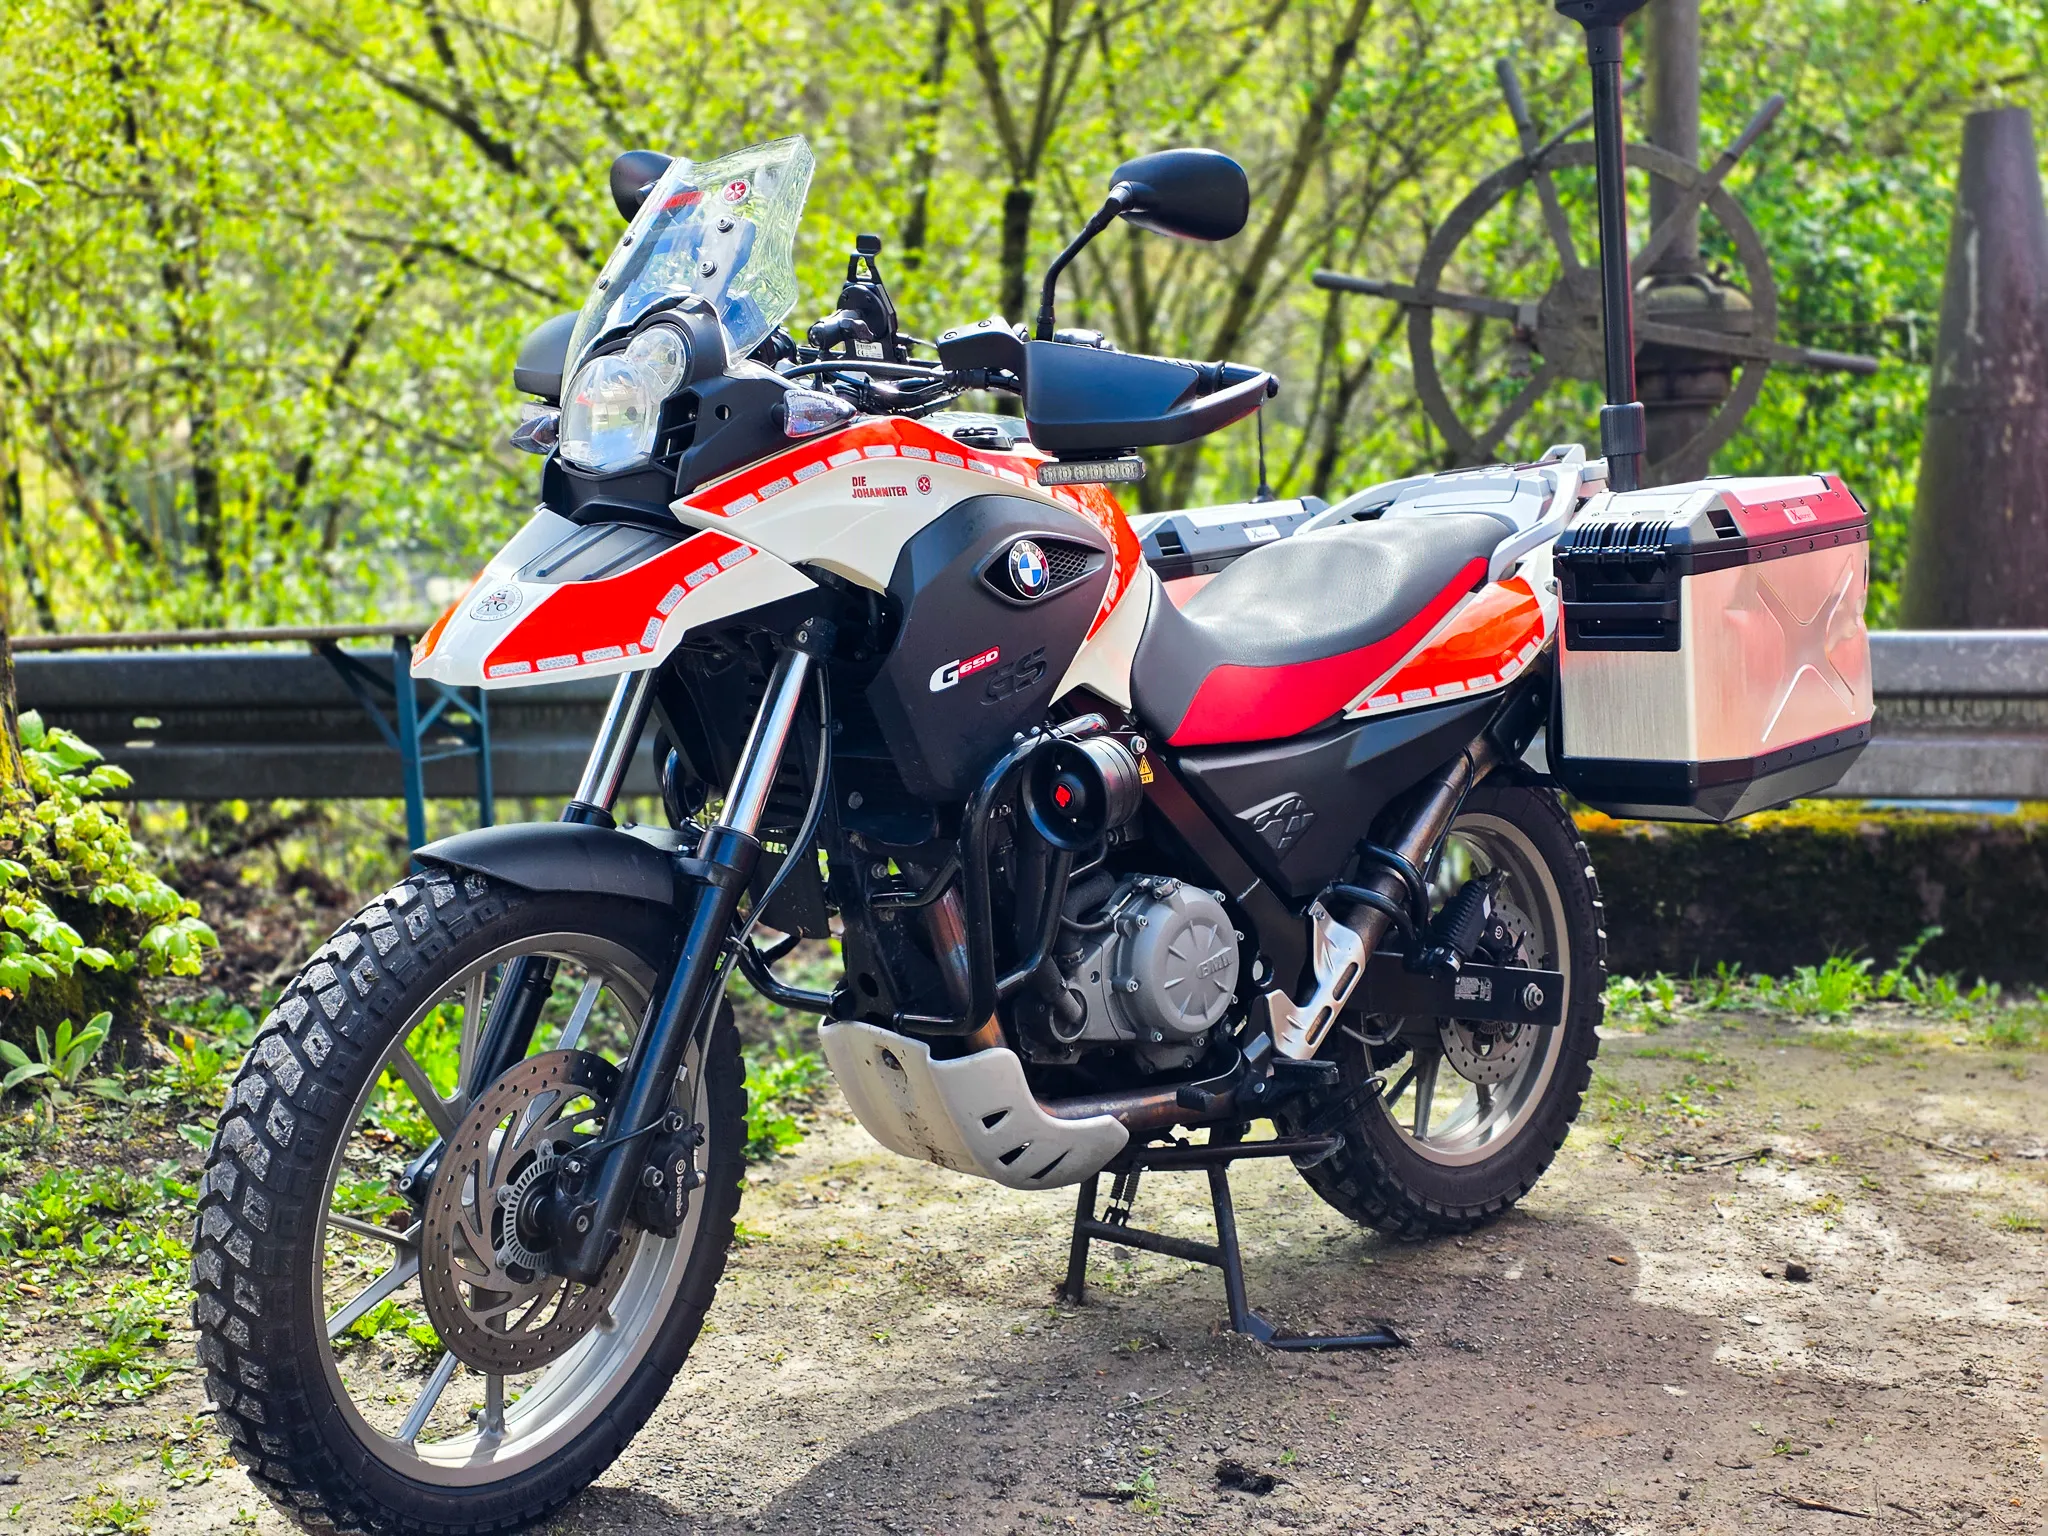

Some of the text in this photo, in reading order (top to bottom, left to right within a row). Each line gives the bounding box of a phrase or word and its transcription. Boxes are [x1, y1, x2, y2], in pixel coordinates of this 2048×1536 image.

[852, 476, 867, 487] DIE
[851, 486, 908, 499] JOHANNITER
[1012, 542, 1044, 562] BMW
[980, 646, 1048, 706] GS
[675, 1175, 685, 1217] brembo
